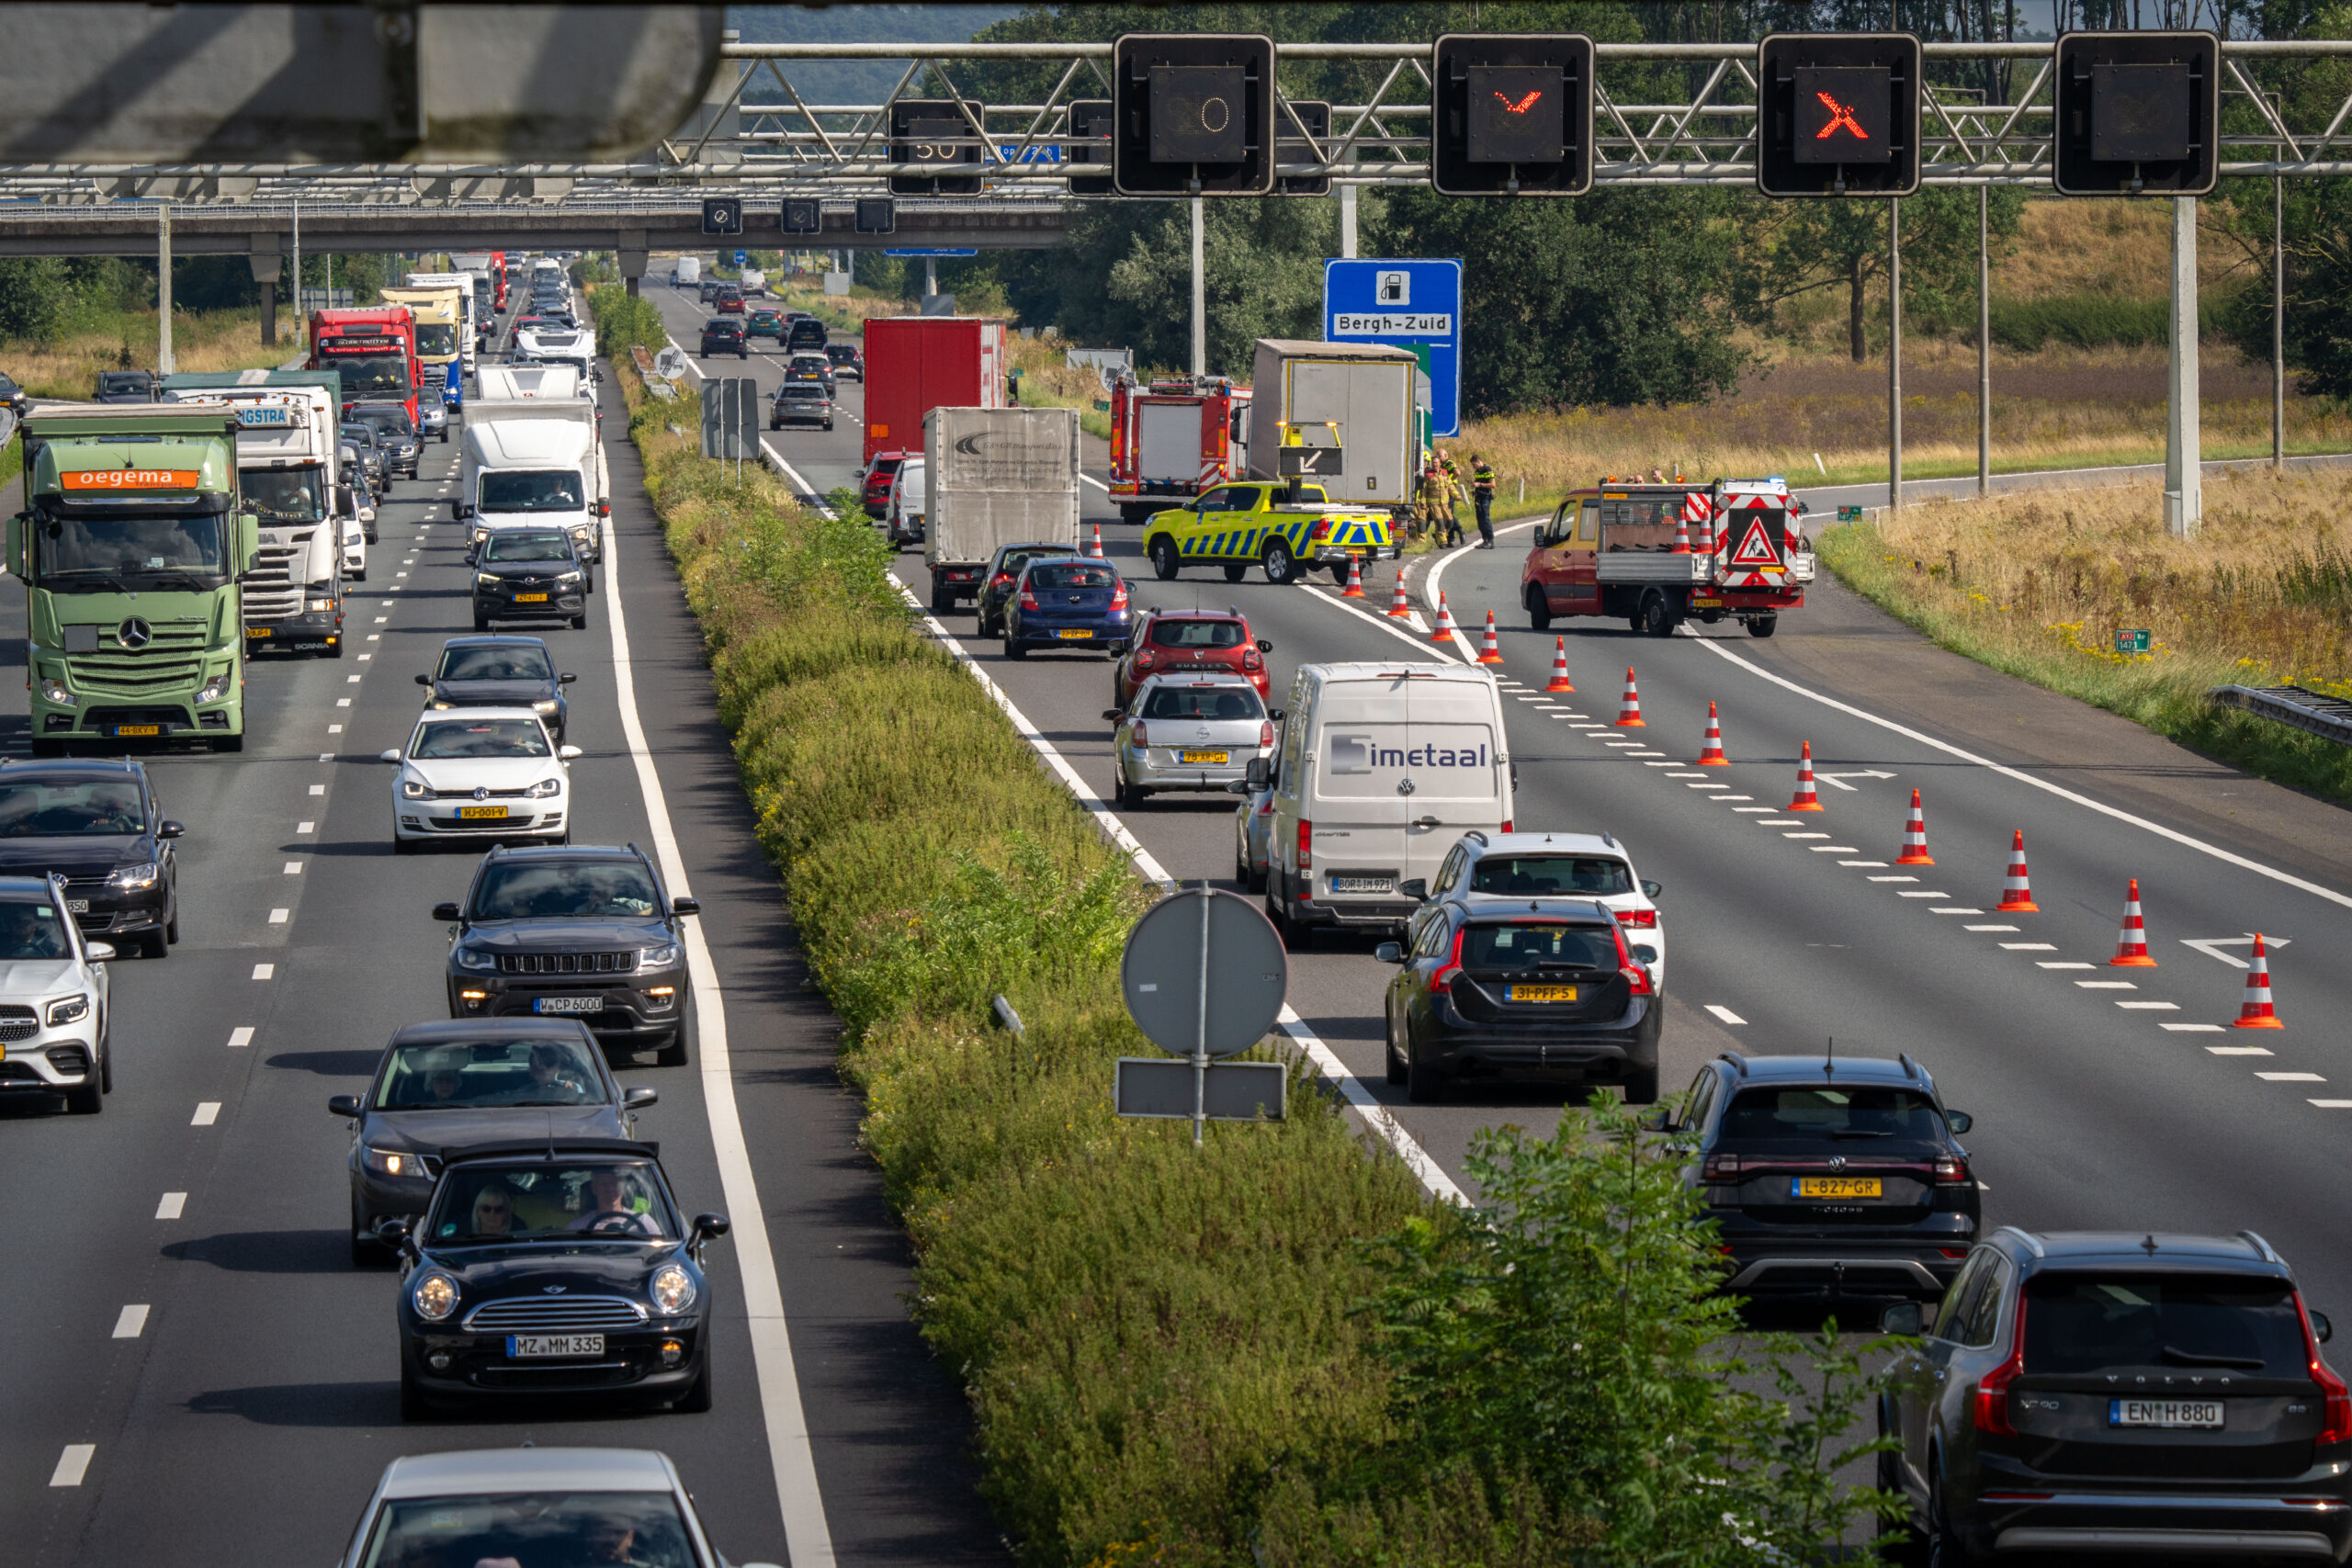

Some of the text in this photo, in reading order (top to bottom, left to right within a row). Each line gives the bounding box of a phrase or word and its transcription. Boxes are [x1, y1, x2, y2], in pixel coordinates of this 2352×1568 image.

[1339, 315, 1447, 334] Bergh-Zuid
[80, 471, 173, 486] oegema
[135, 481, 184, 491] transport
[2121, 632, 2133, 640] A12
[1185, 752, 1226, 761] 78-XR-GF
[465, 808, 504, 817] HJ-001-V
[1339, 879, 1356, 889] BOR
[1374, 879, 1390, 889] 971
[1517, 987, 1569, 998] 31-PFF-5
[540, 998, 602, 1010] W CP 6000
[1804, 1179, 1874, 1194] L-827-GR
[516, 1336, 603, 1354] MZ MM 335
[2106, 1375, 2231, 1384] VOLVO
[2128, 1403, 2216, 1422] EN H 880
